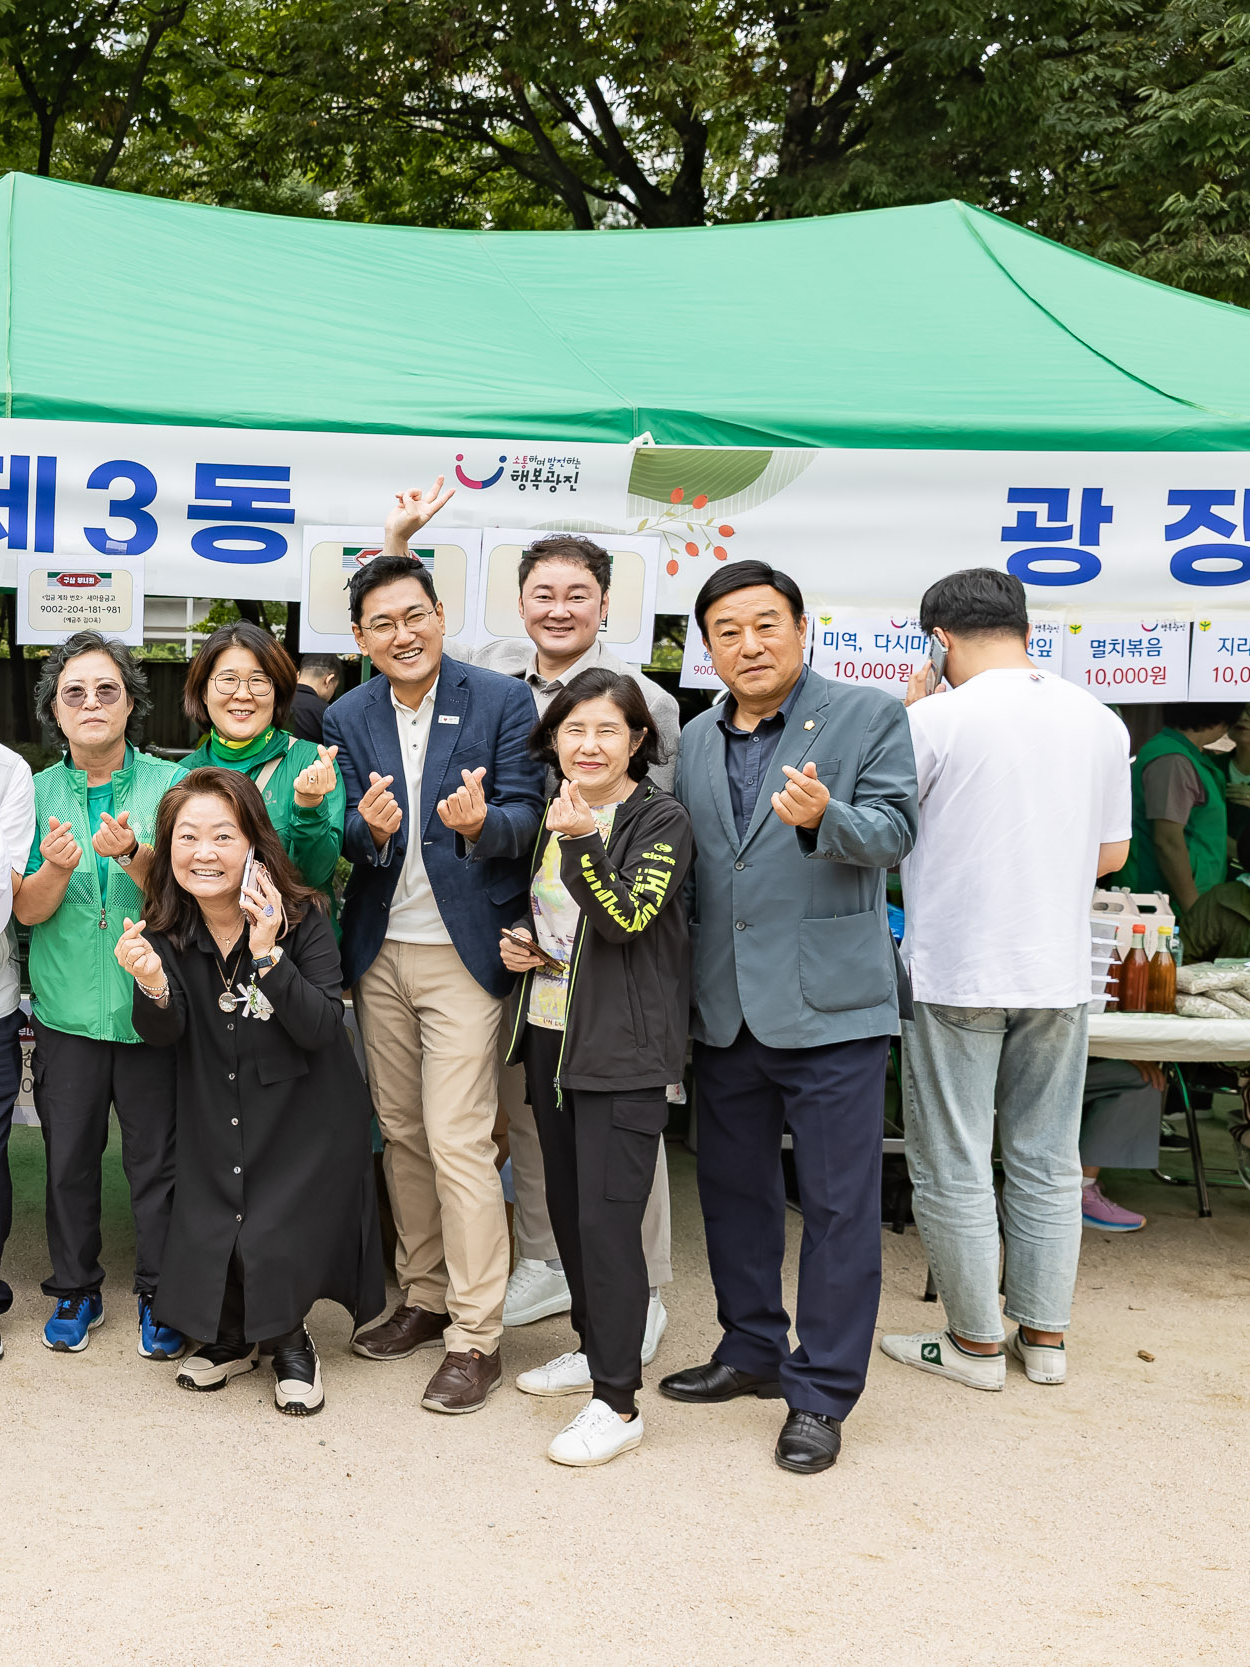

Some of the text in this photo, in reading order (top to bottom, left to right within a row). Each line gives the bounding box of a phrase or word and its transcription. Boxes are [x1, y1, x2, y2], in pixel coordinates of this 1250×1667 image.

[512, 454, 582, 470] 소통하며 발전하는
[510, 467, 580, 493] 행복광진
[40, 605, 121, 614] 9002-204-181-981
[823, 631, 929, 655] 미역, 다시마
[1090, 638, 1163, 658] 멸치볶음
[833, 661, 914, 683] 10,000원
[1084, 666, 1167, 688] 10,000원
